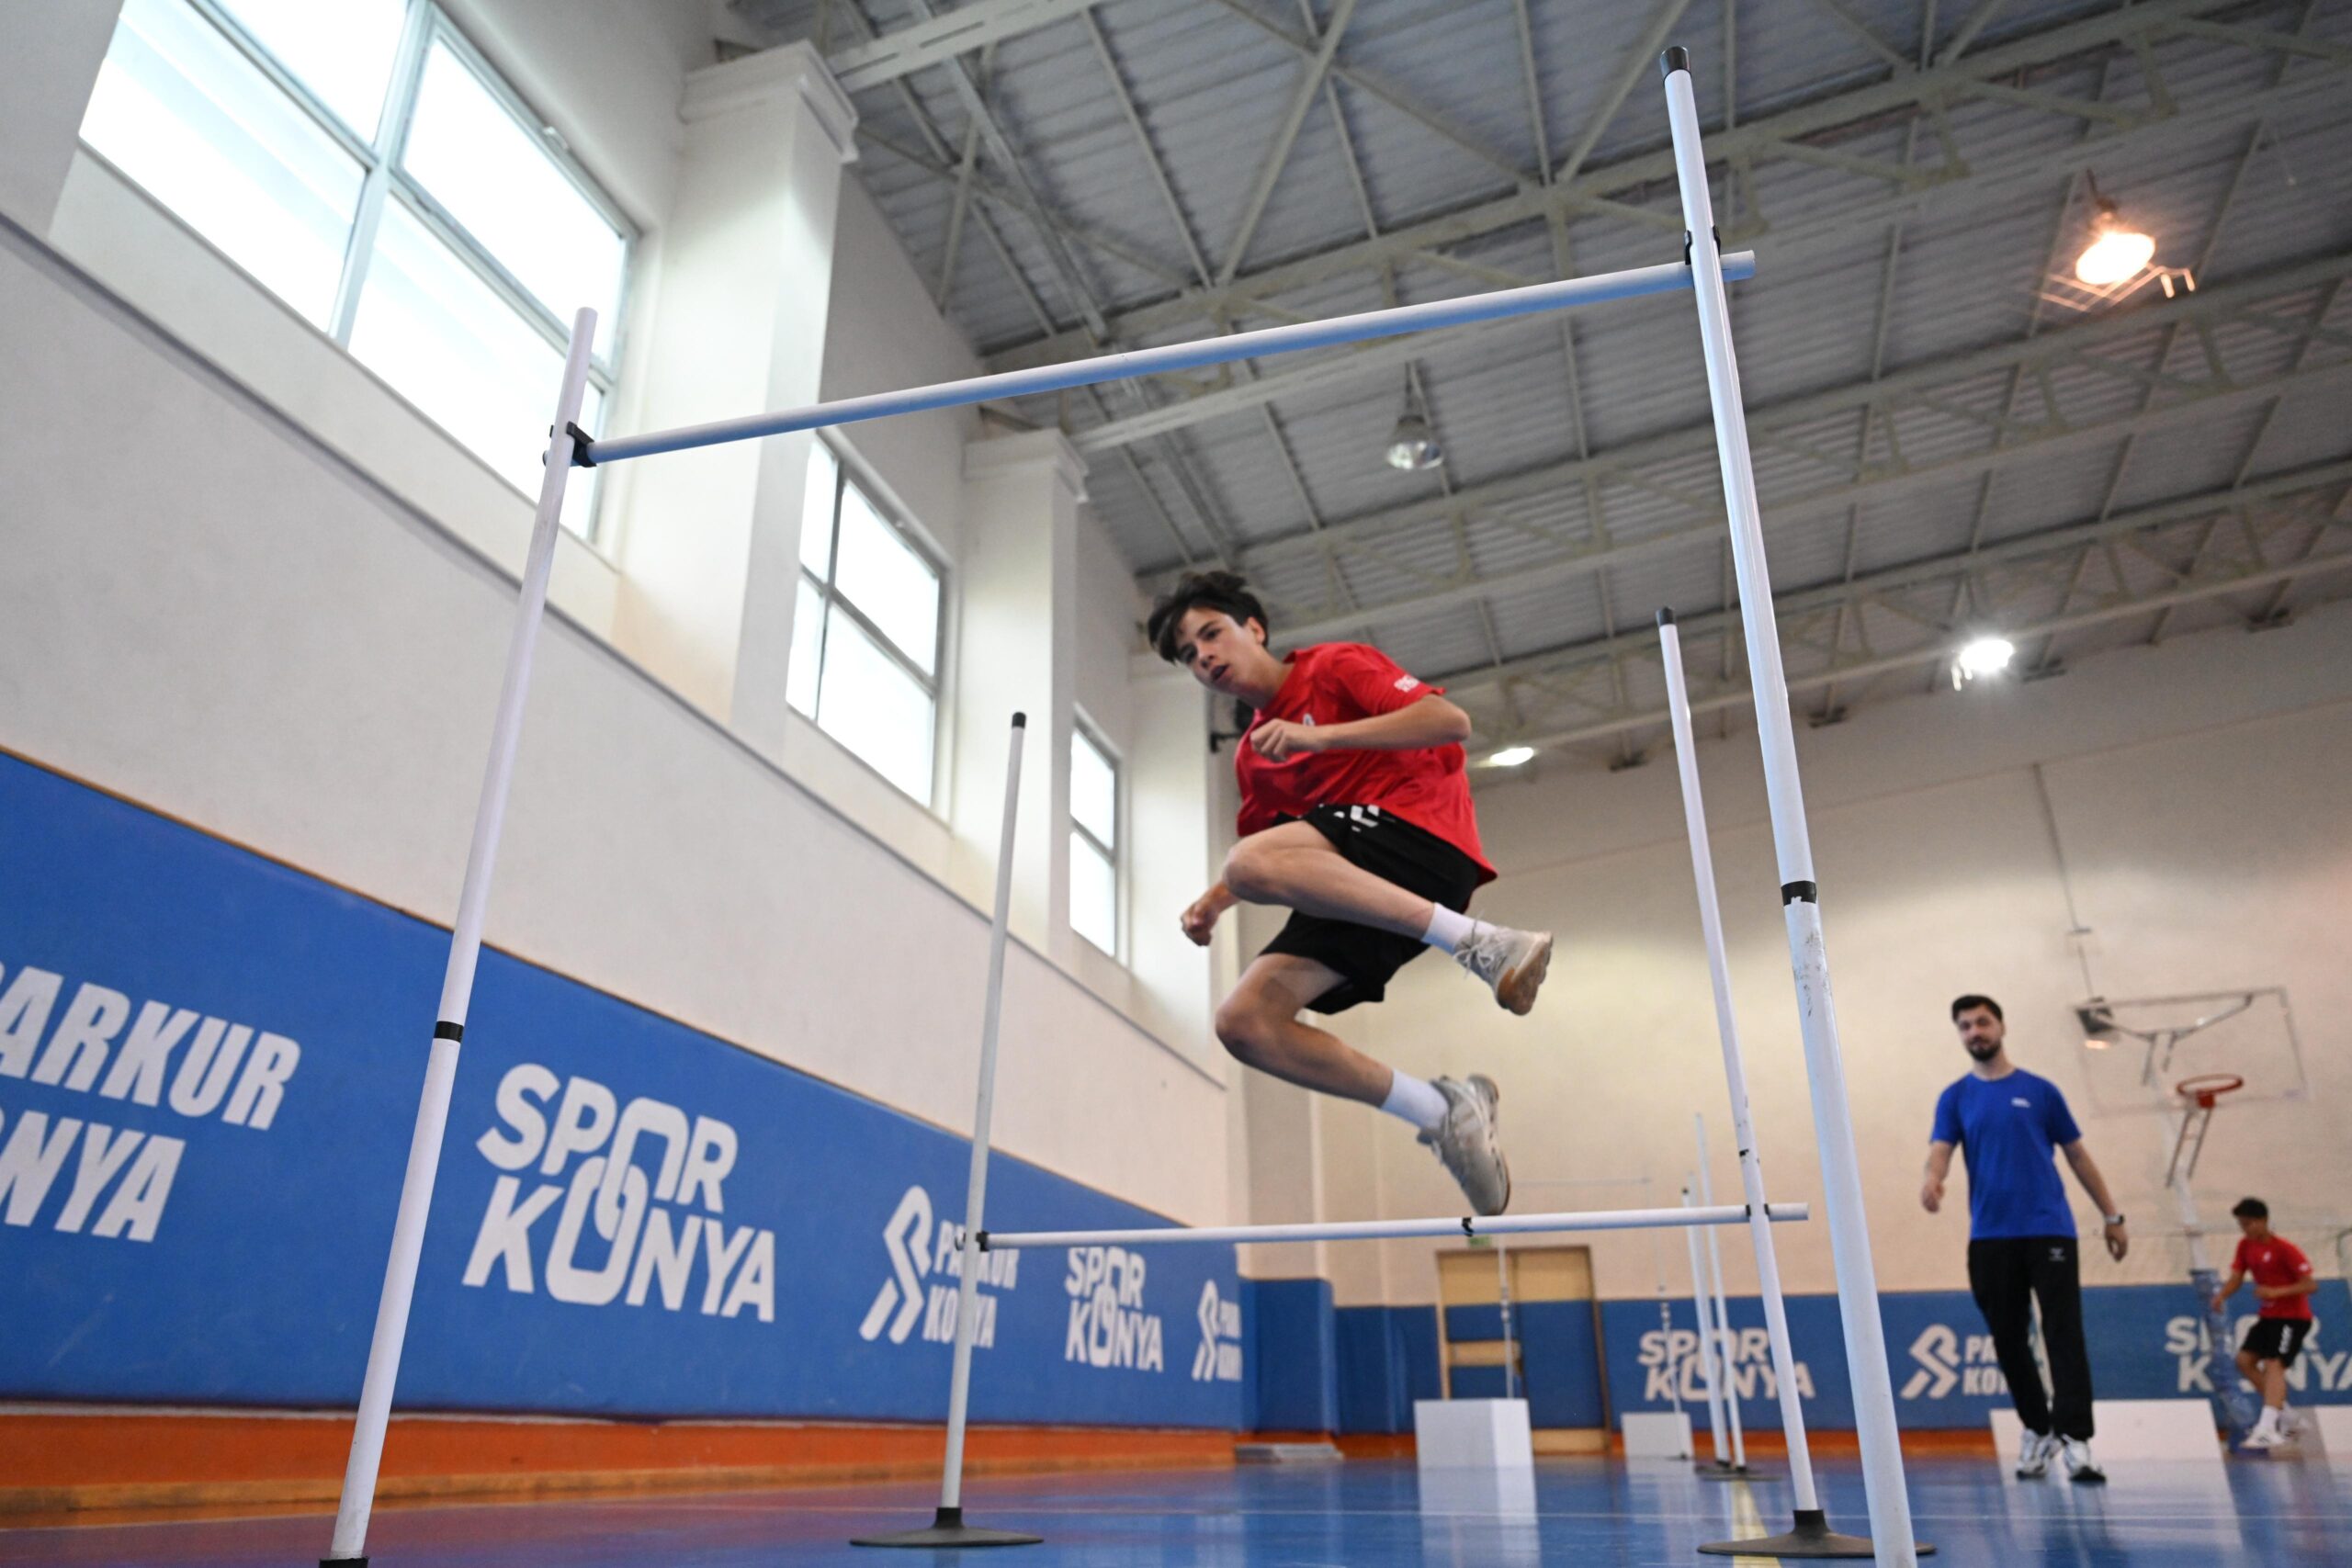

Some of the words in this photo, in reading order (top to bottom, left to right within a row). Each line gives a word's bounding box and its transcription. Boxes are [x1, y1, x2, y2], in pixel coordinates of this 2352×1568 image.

[0, 961, 301, 1131] ARKUR
[0, 1107, 186, 1243] NYA
[476, 1063, 738, 1240] SPOR
[461, 1156, 775, 1323] KONYA
[1065, 1246, 1146, 1328] SPOR
[1065, 1284, 1164, 1372] KONYA
